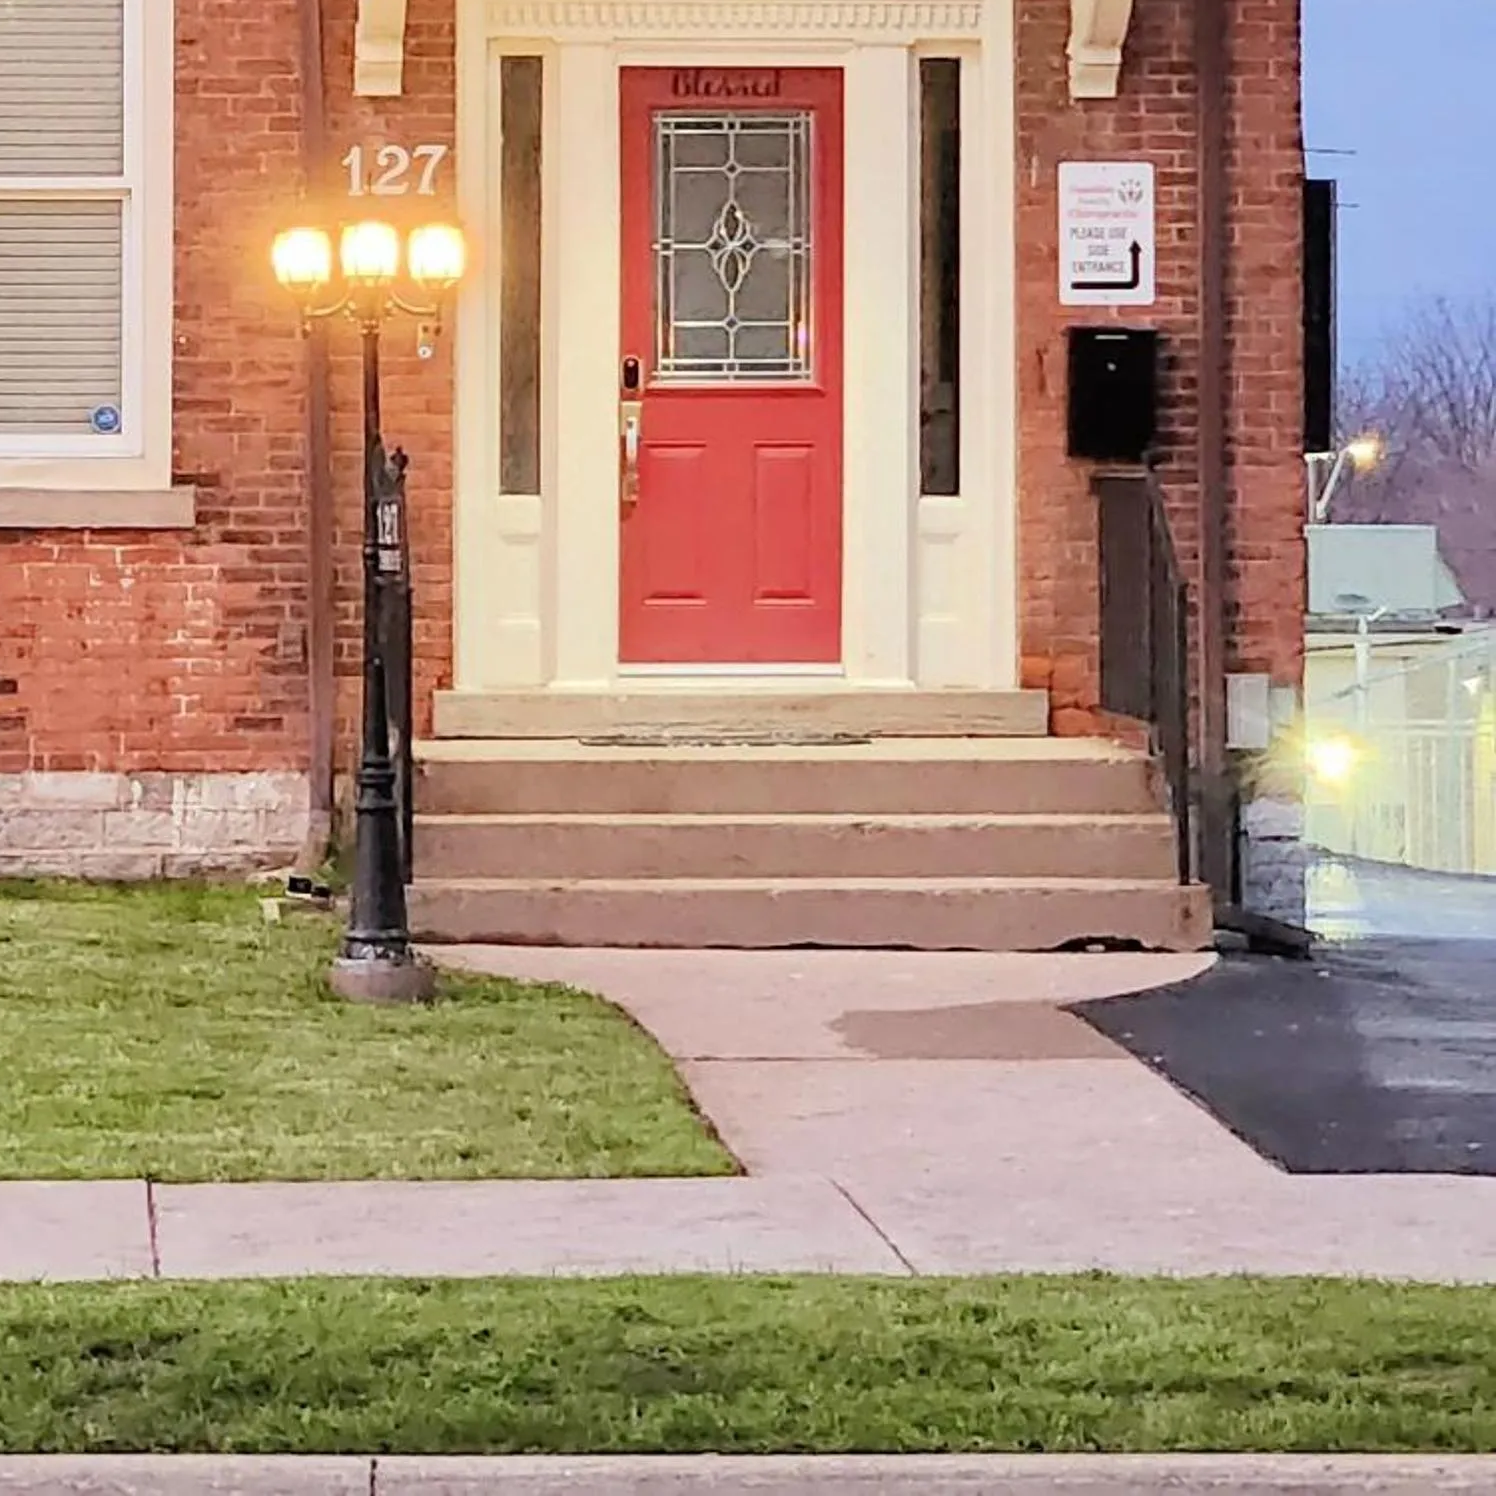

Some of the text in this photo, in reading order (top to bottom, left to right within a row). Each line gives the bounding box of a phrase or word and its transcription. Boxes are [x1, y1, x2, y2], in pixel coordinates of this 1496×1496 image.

[672, 68, 781, 97] Blessed
[342, 144, 448, 196] 127
[1070, 227, 1104, 239] PLEASE
[1073, 261, 1126, 273] ENTRANCE
